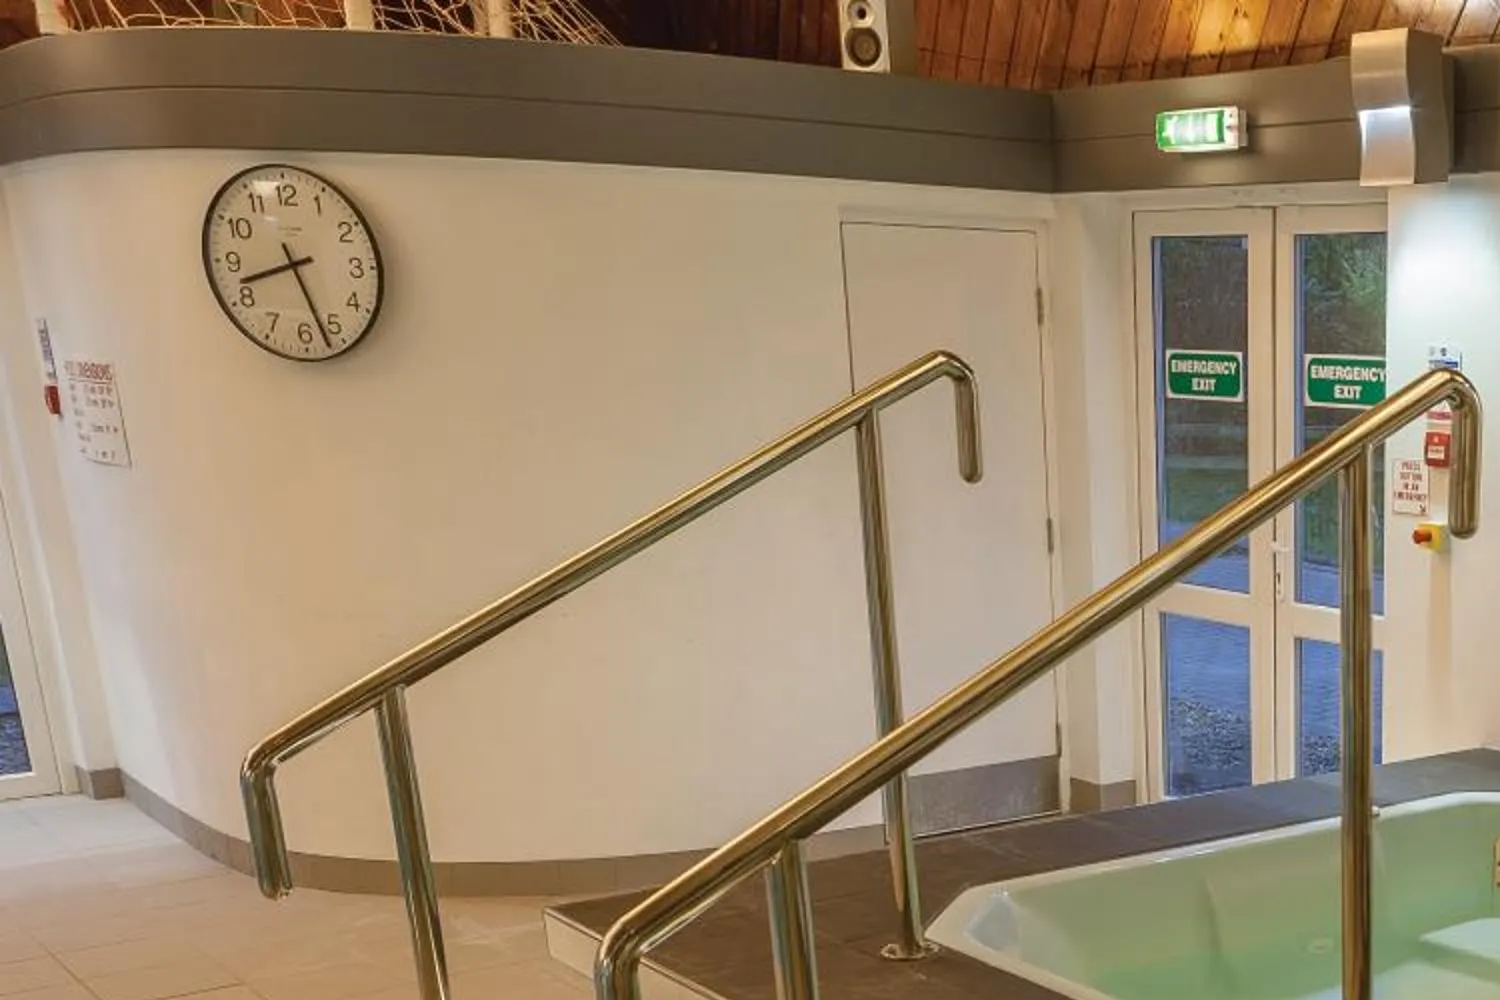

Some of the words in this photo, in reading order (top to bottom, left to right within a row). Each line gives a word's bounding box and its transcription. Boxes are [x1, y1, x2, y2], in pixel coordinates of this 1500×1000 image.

[248, 191, 265, 214] 11
[276, 184, 299, 207] 12
[313, 195, 322, 217] 1
[228, 217, 253, 240] 10
[337, 221, 353, 244] 2
[225, 251, 241, 273] 9
[349, 257, 365, 279] 3
[239, 286, 256, 308] 8
[346, 292, 361, 312] 4
[265, 312, 280, 333] 7
[297, 322, 313, 344] 6
[327, 313, 342, 336] 5
[1171, 359, 1237, 376] EMERGENCY
[1310, 365, 1386, 383] EMERGENCY
[1191, 377, 1216, 392] EXIT
[1333, 384, 1362, 400] EXIT
